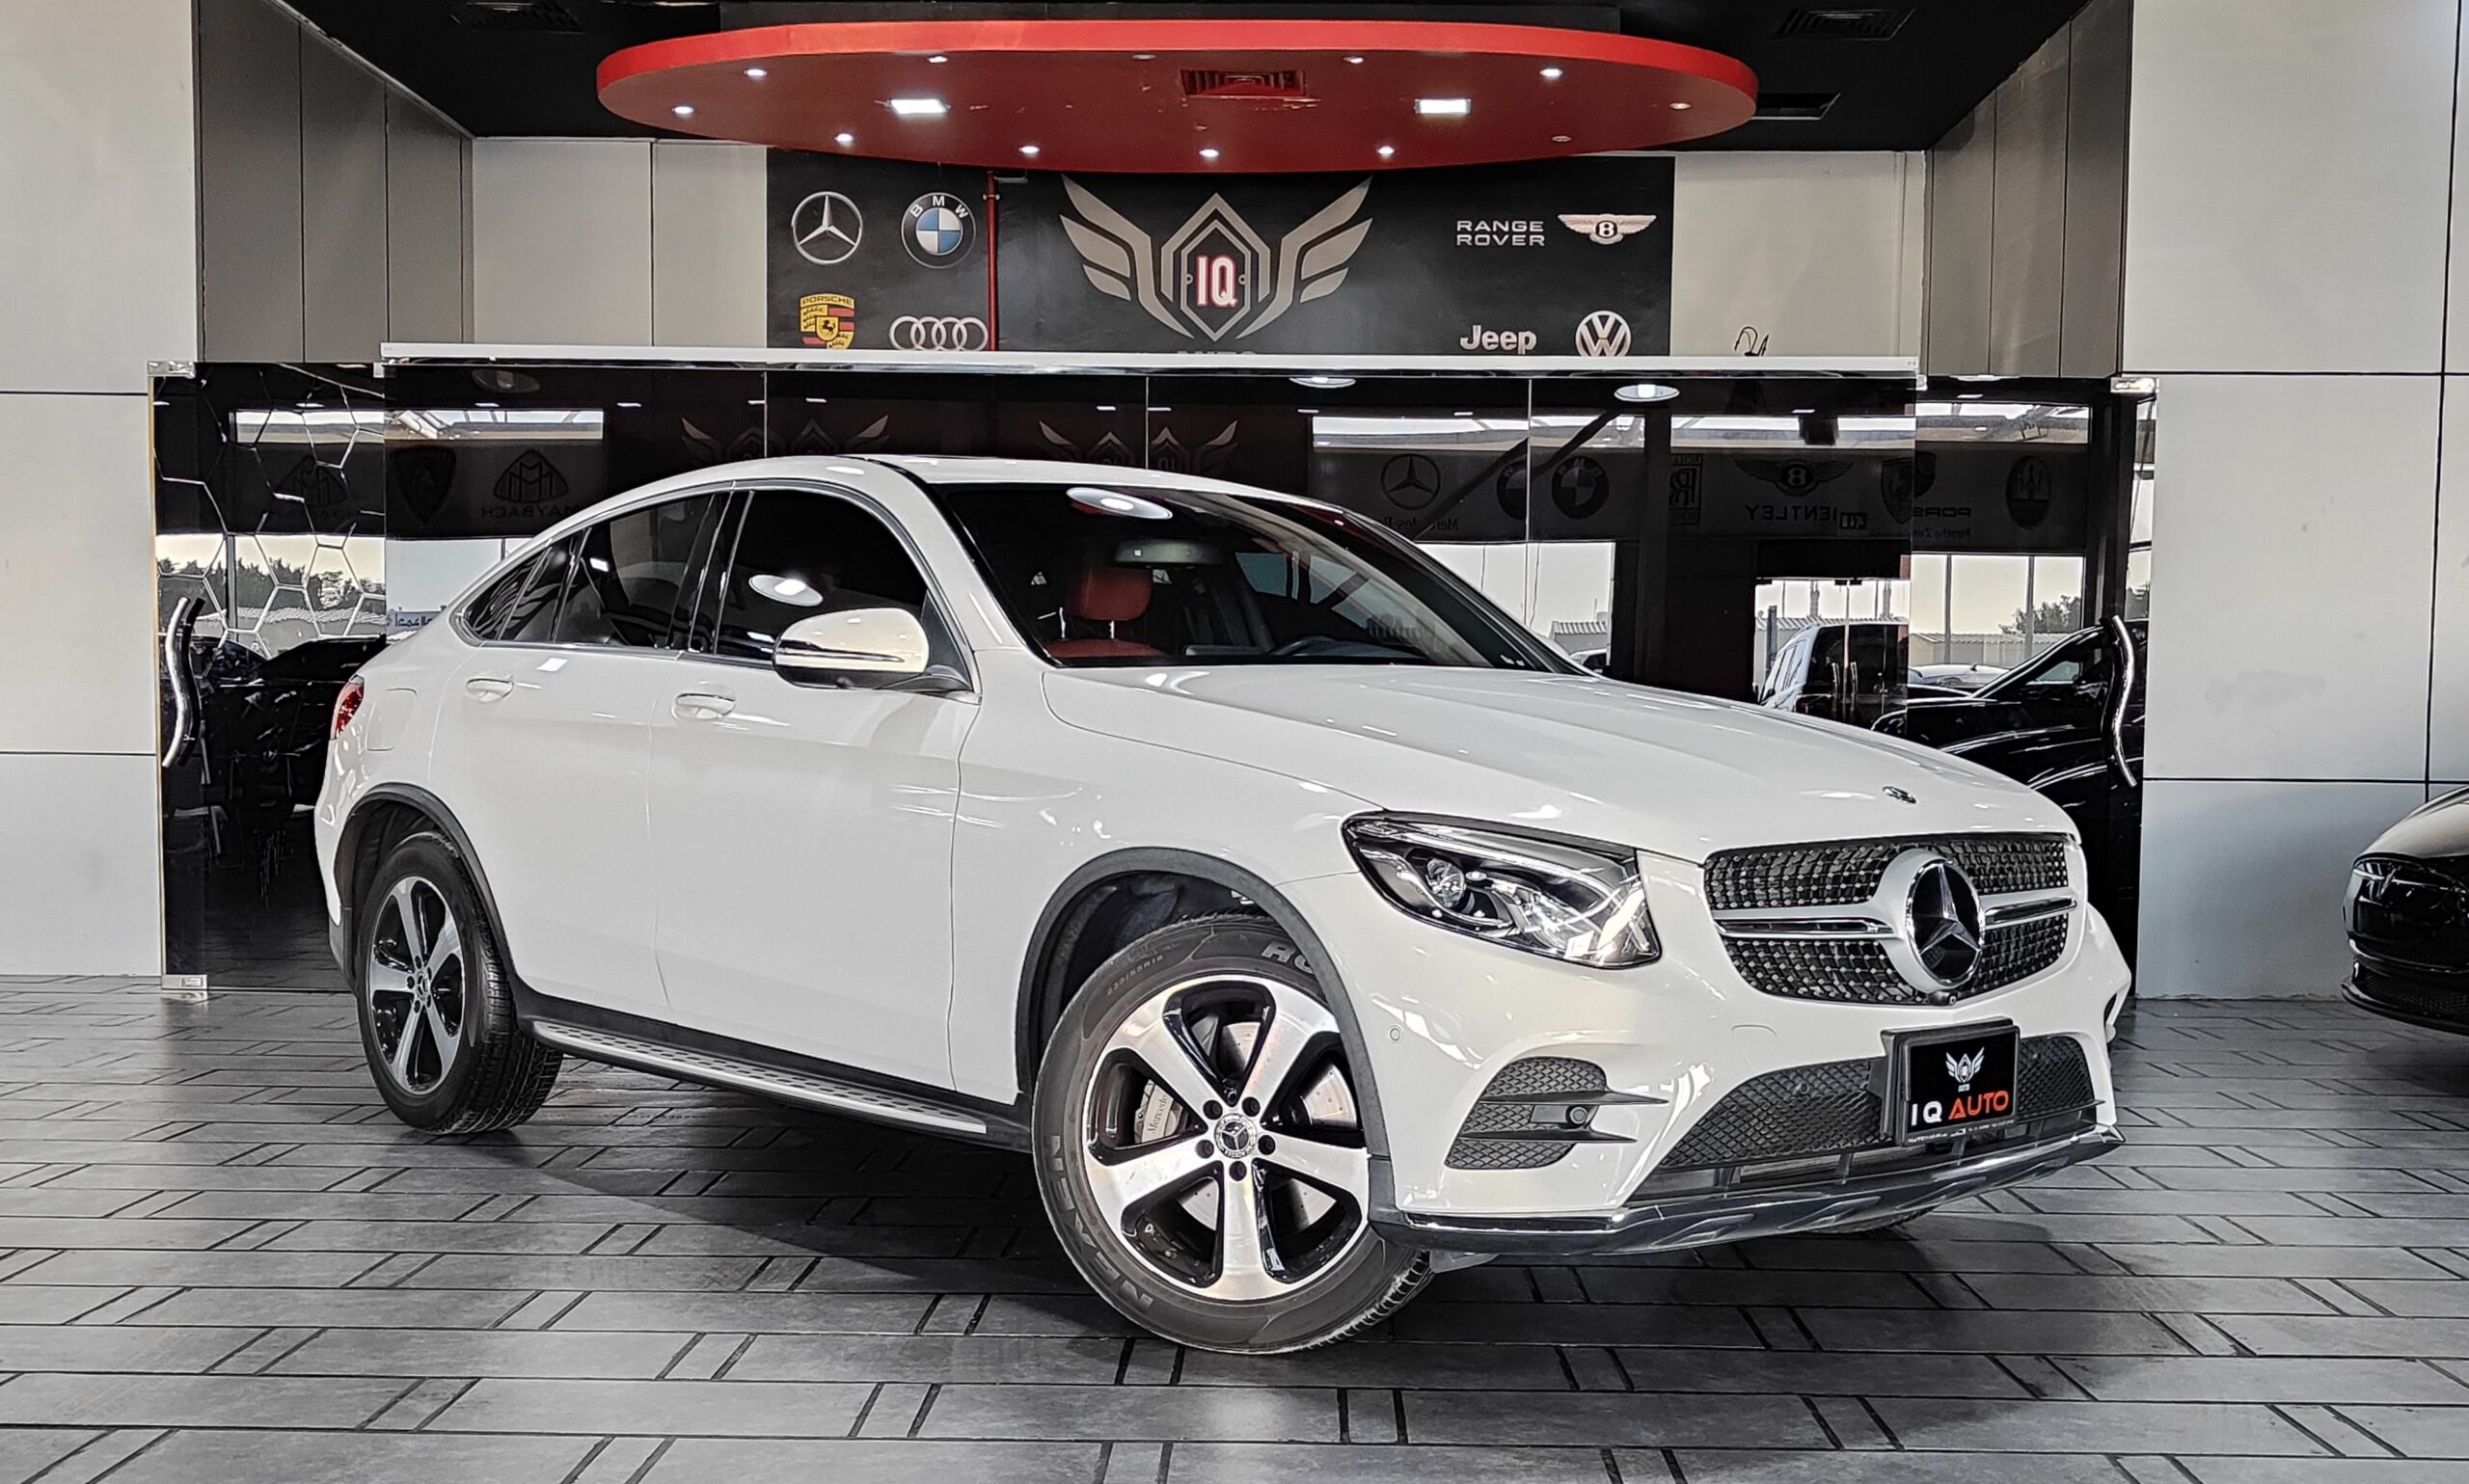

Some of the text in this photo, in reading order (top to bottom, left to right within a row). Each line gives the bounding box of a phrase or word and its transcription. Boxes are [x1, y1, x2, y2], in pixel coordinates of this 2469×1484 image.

[909, 195, 968, 219] BMW
[1457, 220, 1543, 232] RANGE
[1456, 234, 1545, 246] ROVER
[1196, 255, 1237, 308] IQ
[801, 295, 853, 306] PORSCHE
[1460, 325, 1536, 355] Jeep
[1948, 1091, 2009, 1120] AUTO
